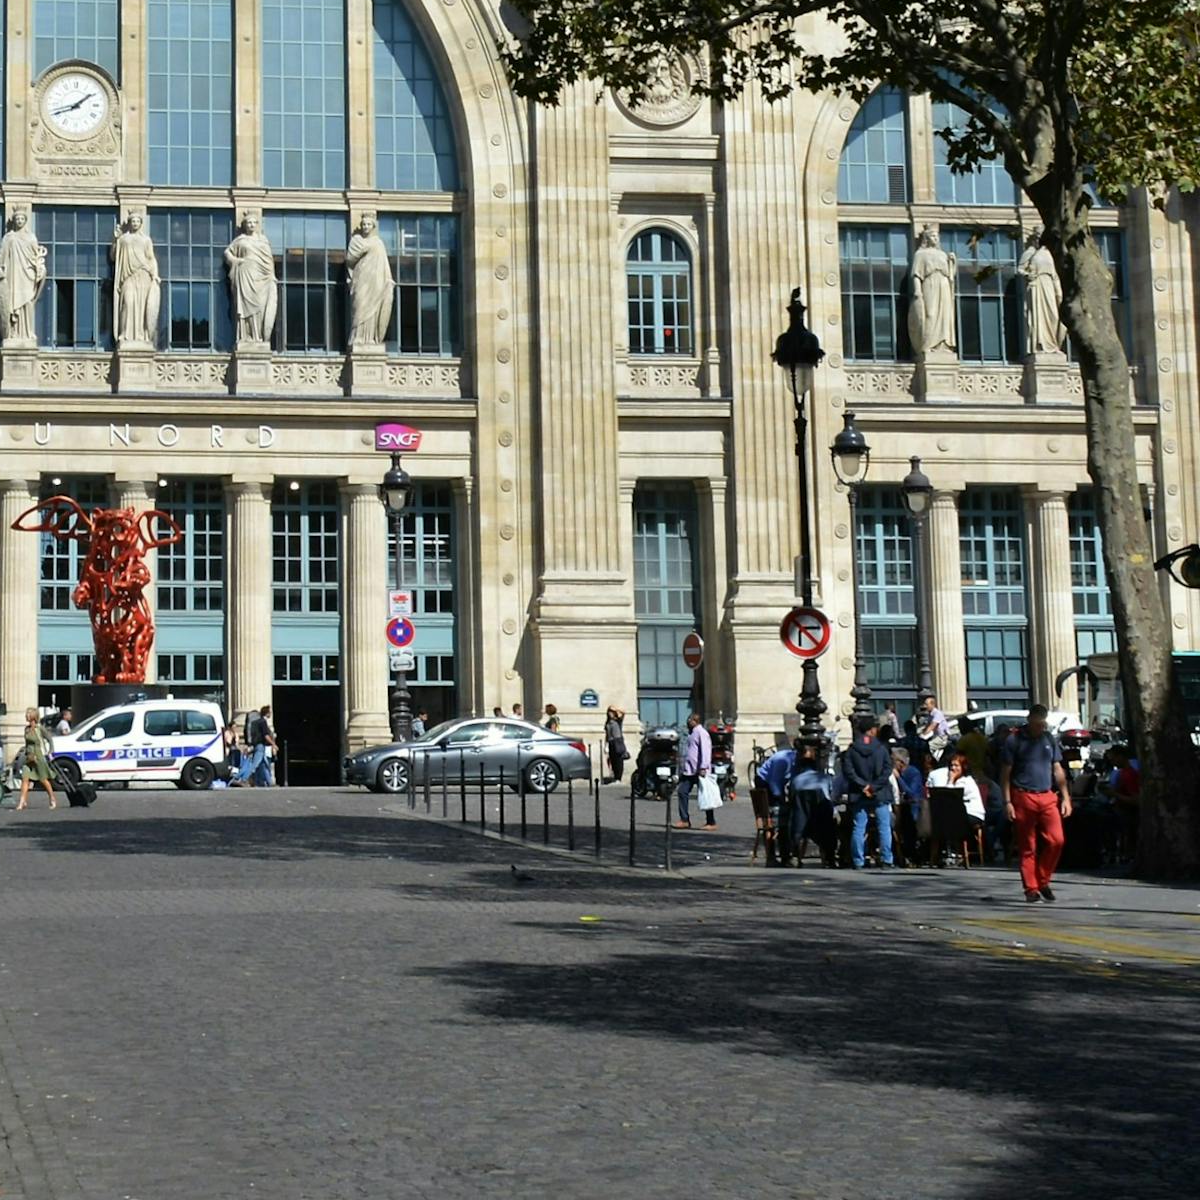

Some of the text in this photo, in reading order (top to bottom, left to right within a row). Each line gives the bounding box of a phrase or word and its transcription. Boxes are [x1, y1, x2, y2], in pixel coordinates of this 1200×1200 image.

[109, 422, 275, 447] NORD
[378, 432, 420, 446] SNCF
[114, 746, 172, 759] POLICE
